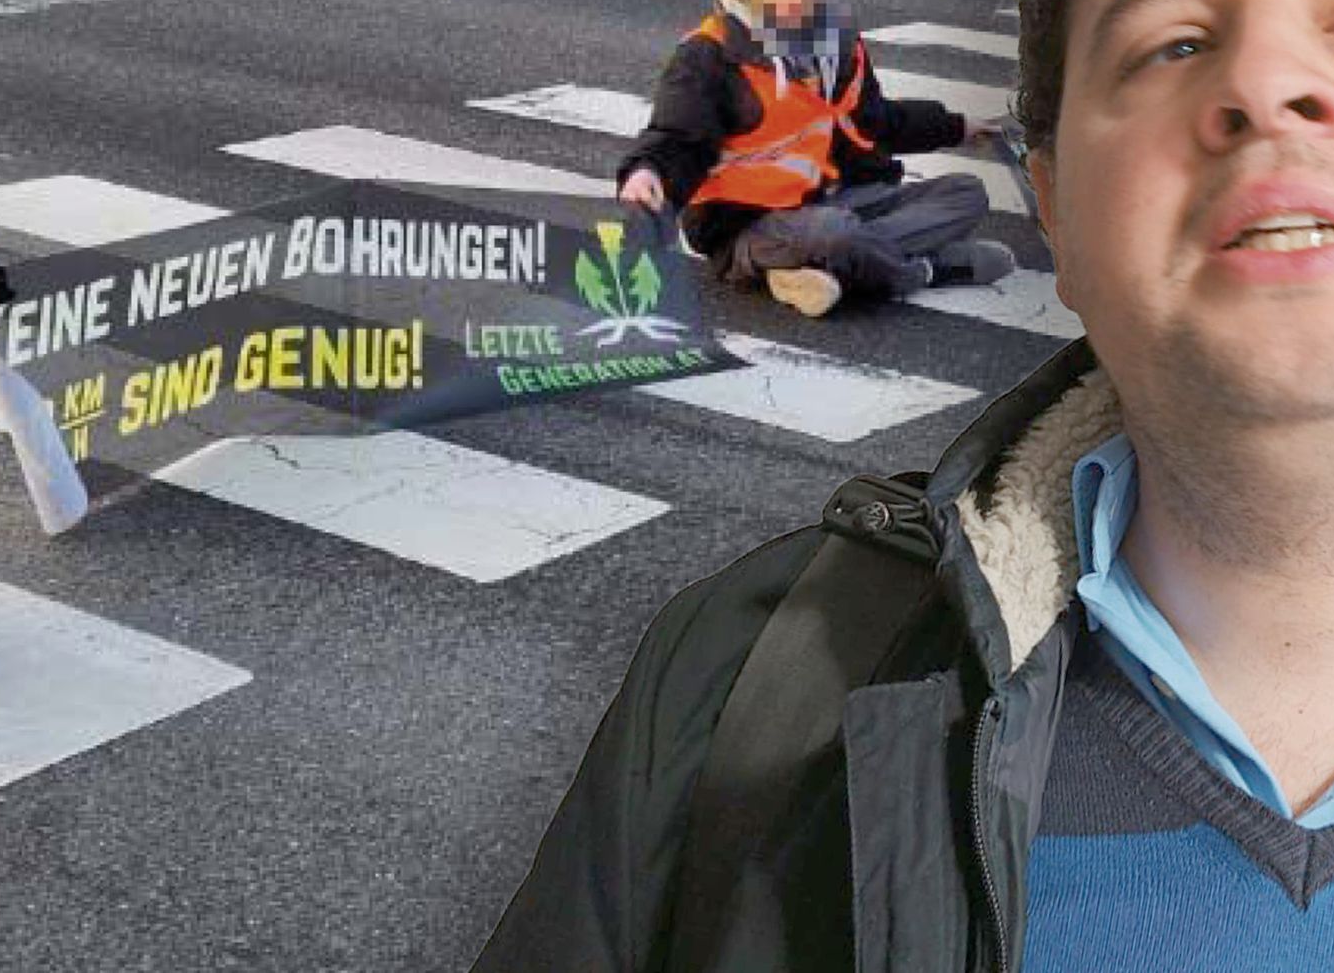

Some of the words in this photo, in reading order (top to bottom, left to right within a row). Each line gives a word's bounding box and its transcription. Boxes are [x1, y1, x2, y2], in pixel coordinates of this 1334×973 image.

[127, 231, 275, 327] NEUEN
[281, 215, 547, 284] BOHRUNGEN!
[119, 344, 224, 436] SIND
[233, 318, 424, 393] GENUG!
[465, 318, 564, 358] LETZTE
